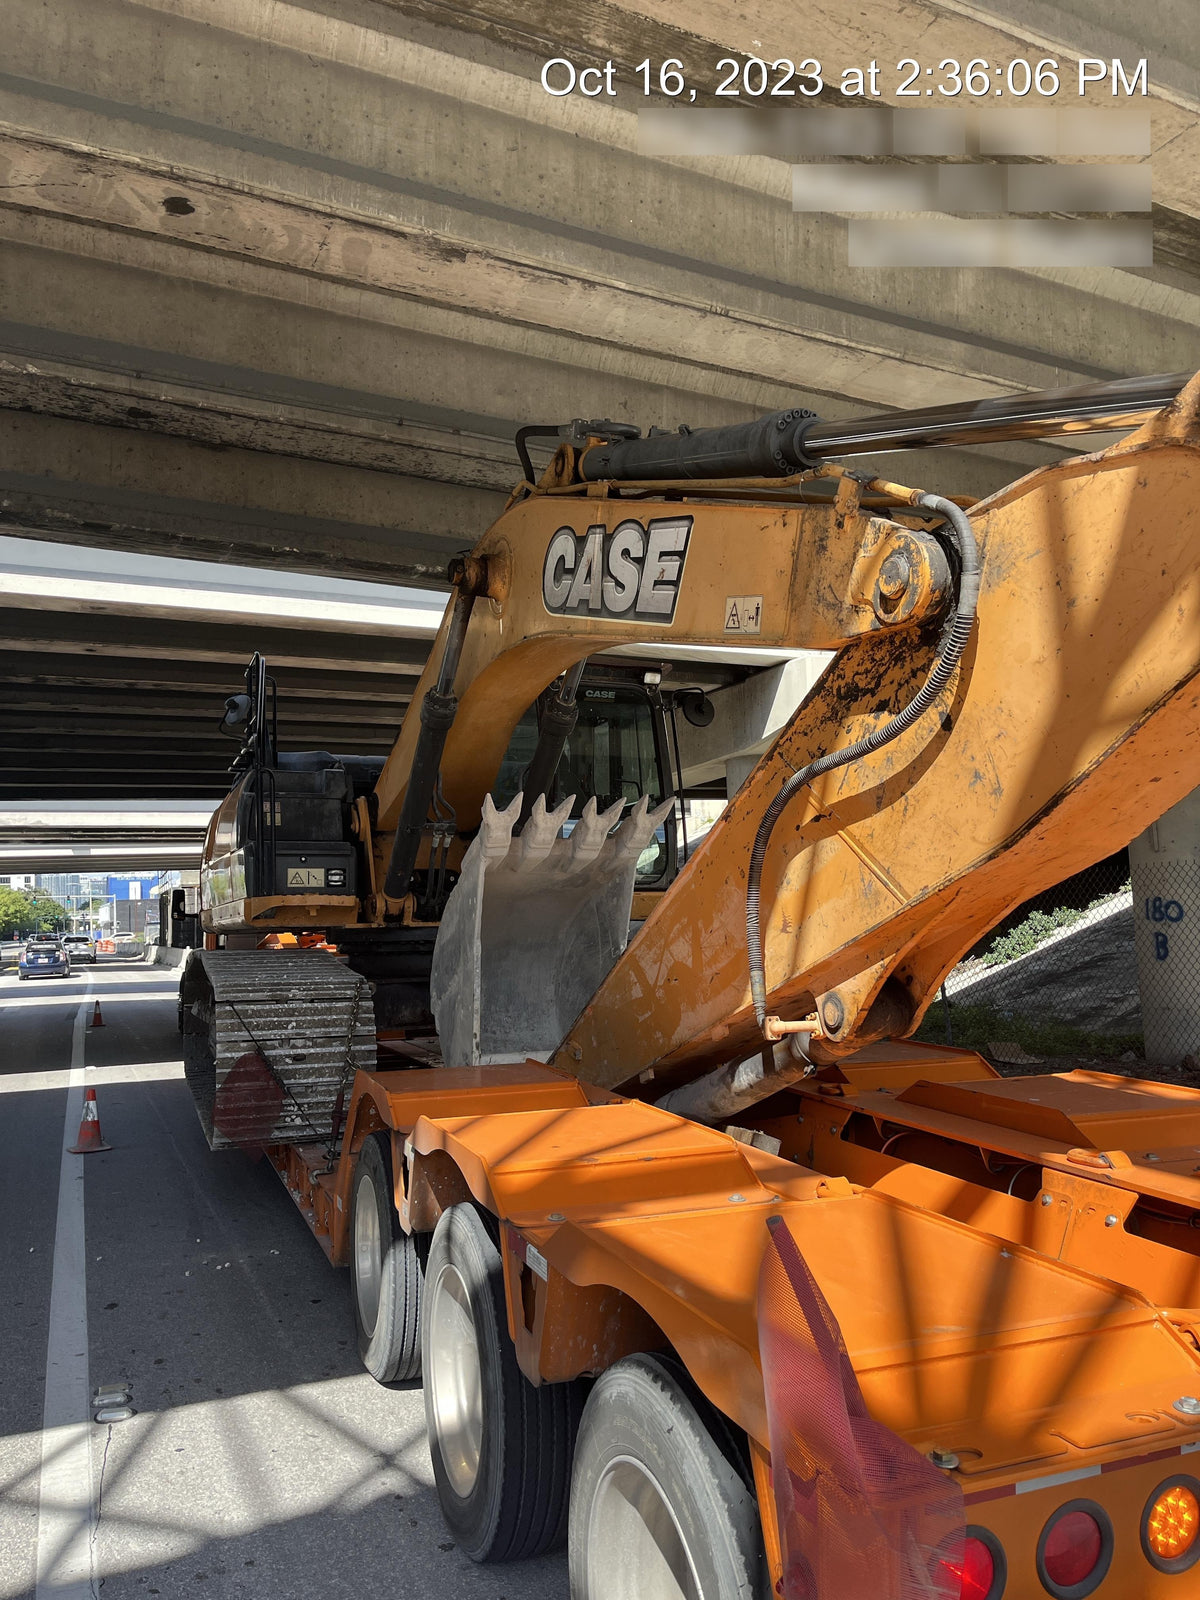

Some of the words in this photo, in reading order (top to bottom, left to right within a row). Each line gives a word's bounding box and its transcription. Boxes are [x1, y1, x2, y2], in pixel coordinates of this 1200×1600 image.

[543, 520, 690, 616] CASE
[585, 689, 616, 699] CASE
[1145, 896, 1184, 923] 180
[1154, 931, 1169, 961] B
